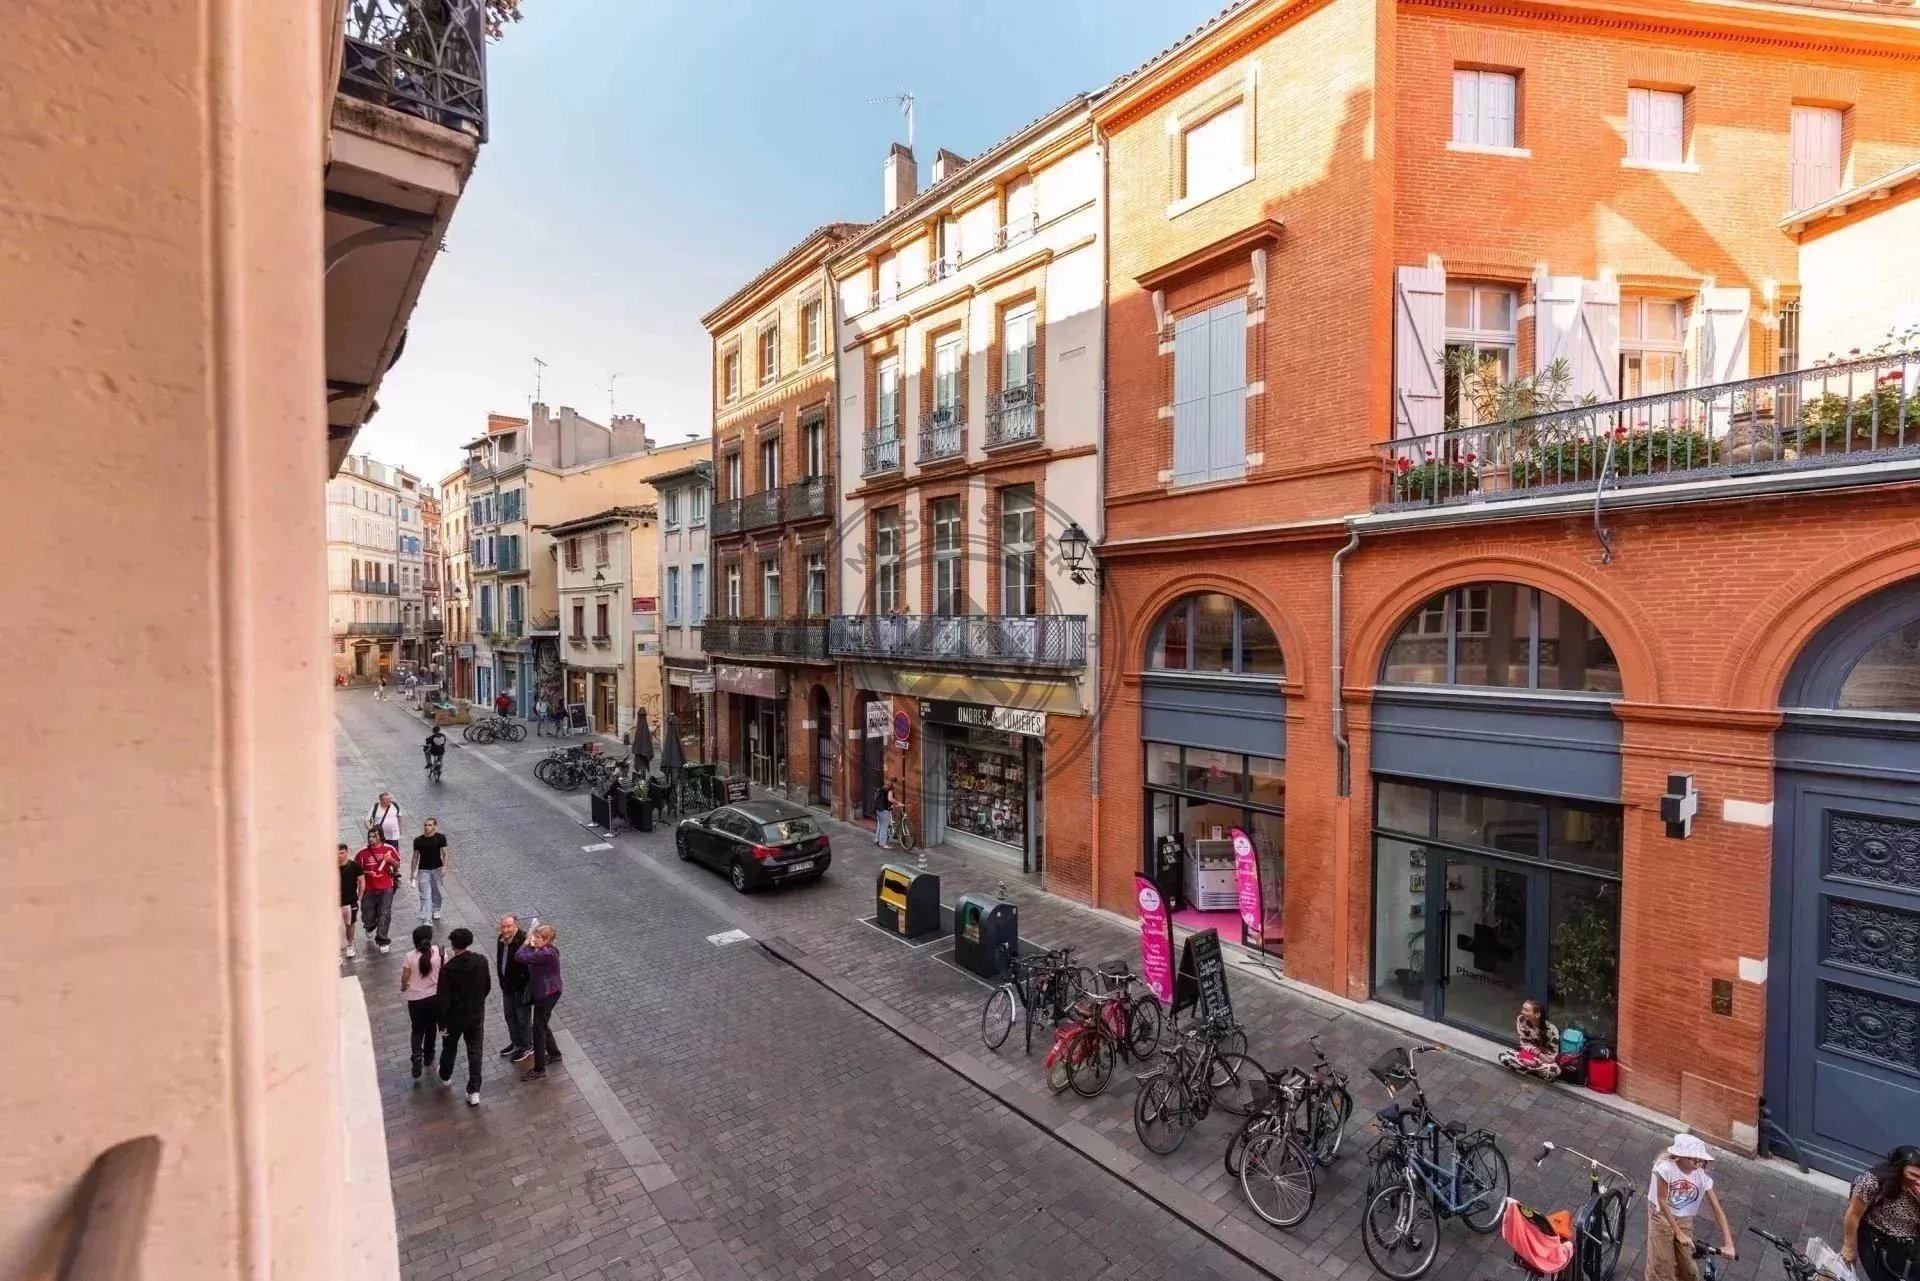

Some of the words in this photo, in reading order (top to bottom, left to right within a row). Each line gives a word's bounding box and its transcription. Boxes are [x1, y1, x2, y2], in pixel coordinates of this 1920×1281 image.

[958, 706, 987, 726] OMBRES
[991, 711, 997, 722] &
[1003, 711, 1041, 733] LUMIÈRES
[1456, 965, 1514, 989] Pharmacie
